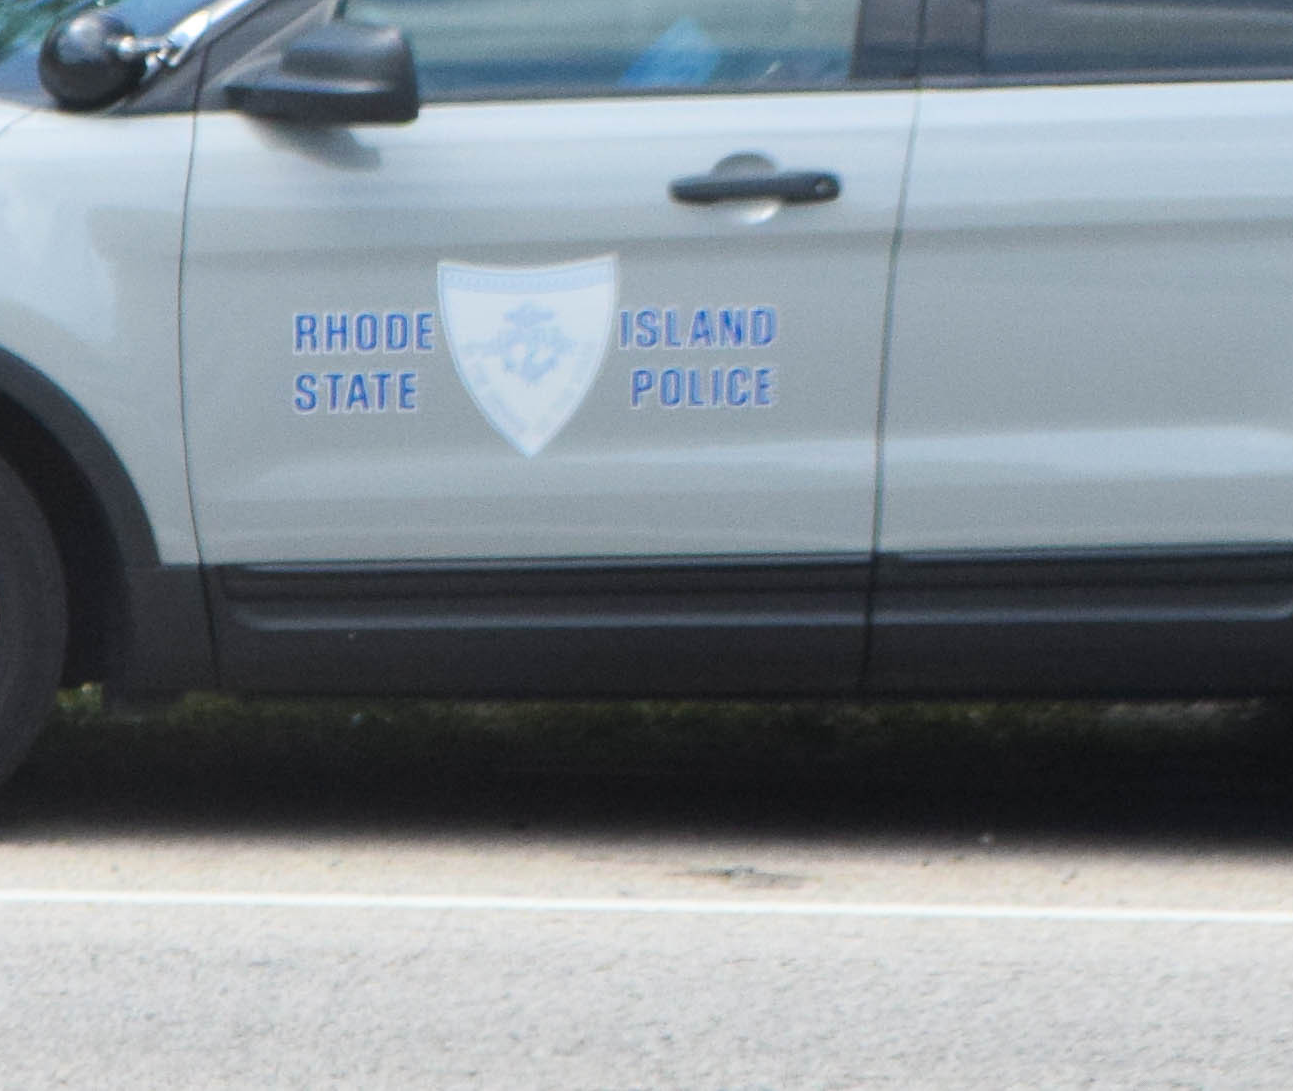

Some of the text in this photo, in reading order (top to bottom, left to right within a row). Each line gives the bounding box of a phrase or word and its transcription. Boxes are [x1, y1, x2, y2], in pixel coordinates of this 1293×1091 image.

[293, 306, 778, 354] RHODE ISLAND
[293, 366, 775, 413] STATE POLICE
